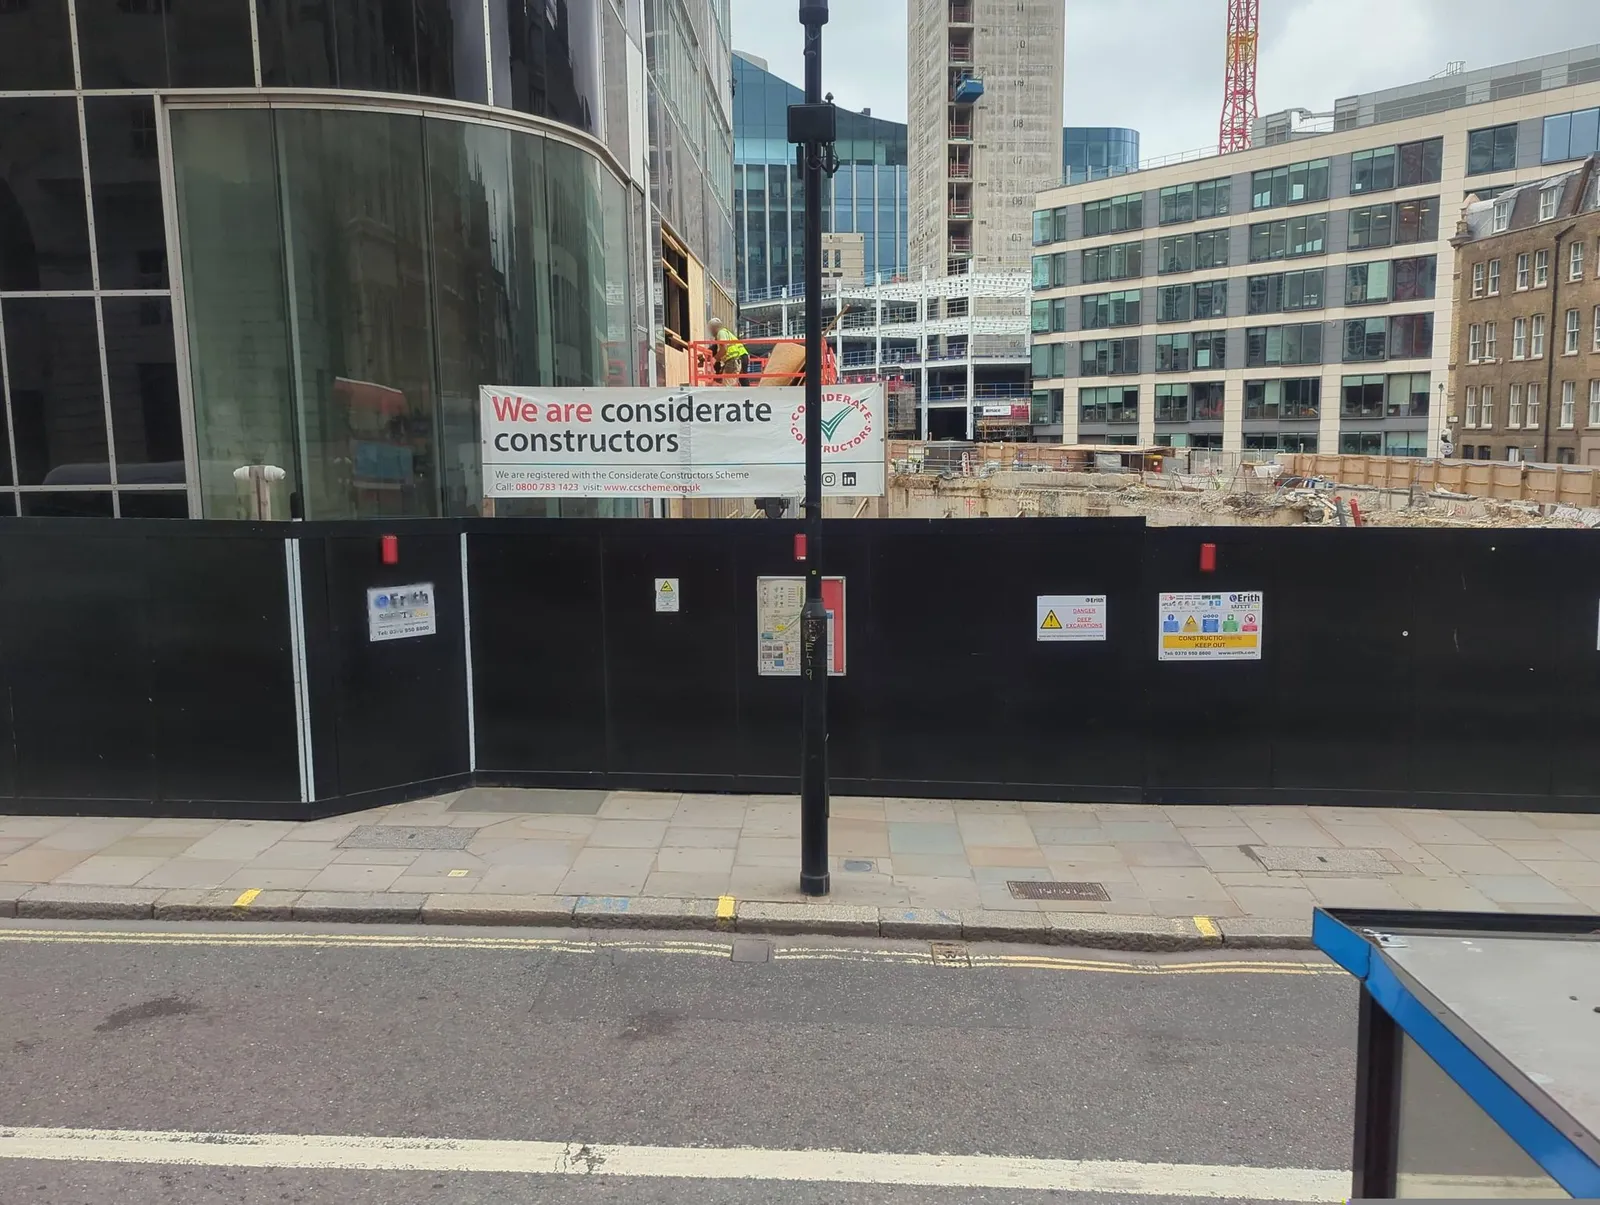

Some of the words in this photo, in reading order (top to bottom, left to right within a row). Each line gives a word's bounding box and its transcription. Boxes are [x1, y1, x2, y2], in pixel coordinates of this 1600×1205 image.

[1013, 118, 1024, 129] 08
[1012, 155, 1023, 165] 07
[1012, 196, 1023, 206] 06
[1011, 233, 1022, 242] 05
[492, 396, 538, 422] We
[546, 403, 593, 422] are
[601, 395, 772, 423] considerate
[791, 393, 873, 421] COIDERATE
[494, 429, 679, 453] constructors
[790, 426, 873, 453] CORUCTORS
[495, 471, 509, 479] We
[527, 470, 570, 482] registered
[571, 471, 591, 479] with
[593, 471, 607, 479] the
[608, 471, 659, 480] Considerate
[660, 471, 714, 480] Constructors
[715, 471, 750, 480] Scheme
[495, 482, 515, 491] Call:
[515, 483, 538, 491] 0800
[540, 483, 556, 491] 783
[559, 483, 579, 491] 1423
[583, 482, 602, 491] visit:
[603, 483, 701, 493] www.ccscheme.org.uk
[389, 591, 429, 607] Erth
[1237, 593, 1260, 602] Erith
